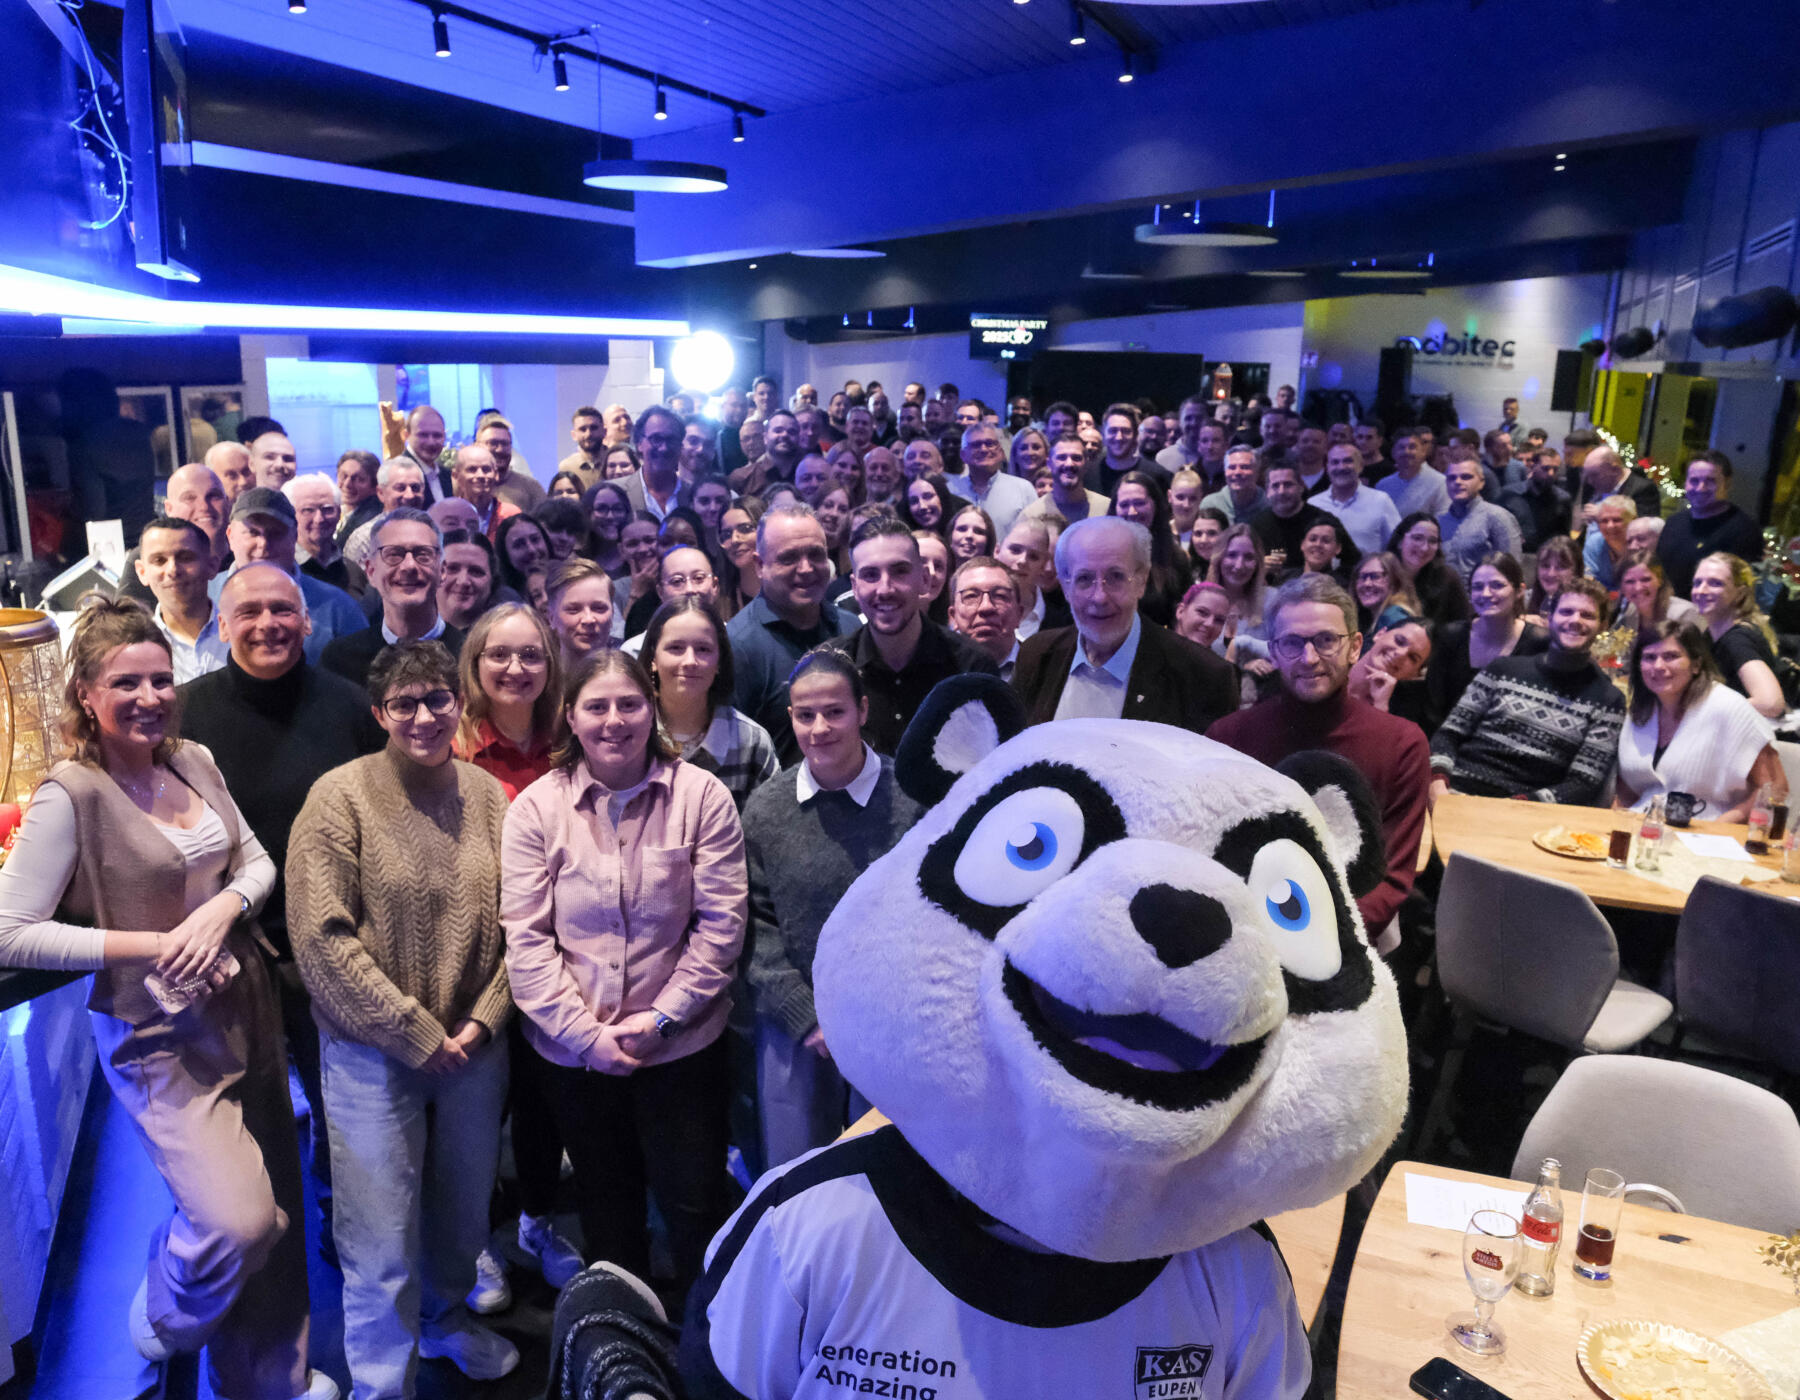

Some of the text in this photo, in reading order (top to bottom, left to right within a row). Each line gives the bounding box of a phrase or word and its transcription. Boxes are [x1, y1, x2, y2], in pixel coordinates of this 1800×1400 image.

[1020, 320, 1047, 329] PARTY
[817, 1345, 956, 1378] eneration
[815, 1364, 938, 1400] Amazing
[1148, 1381, 1196, 1398] EUPEN
